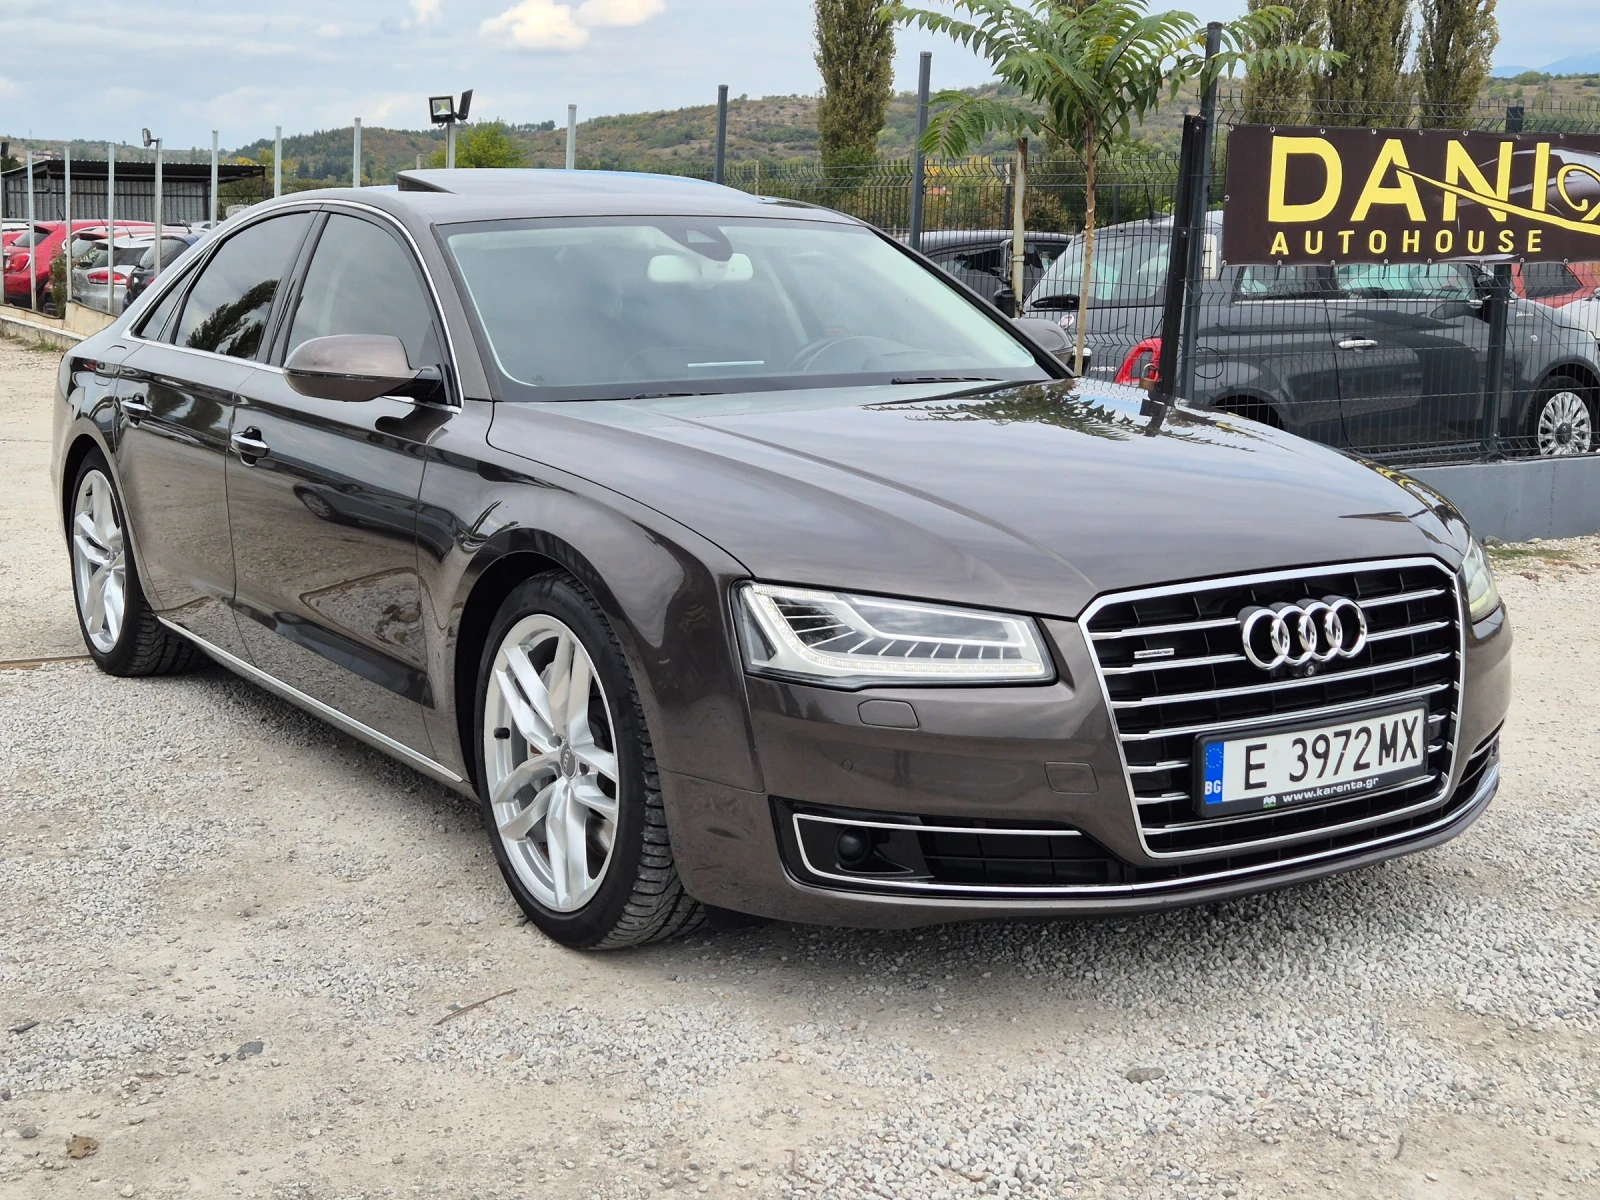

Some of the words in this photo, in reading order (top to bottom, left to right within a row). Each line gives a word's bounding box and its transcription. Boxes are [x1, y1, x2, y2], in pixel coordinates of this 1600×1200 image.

[1270, 229, 1542, 255] AUTOHOUSE
[1244, 743, 1268, 791] E
[1289, 726, 1372, 782] 3972
[1378, 716, 1418, 766] MX
[1205, 780, 1221, 795] BG
[1282, 777, 1379, 802] www.karenta.gr
